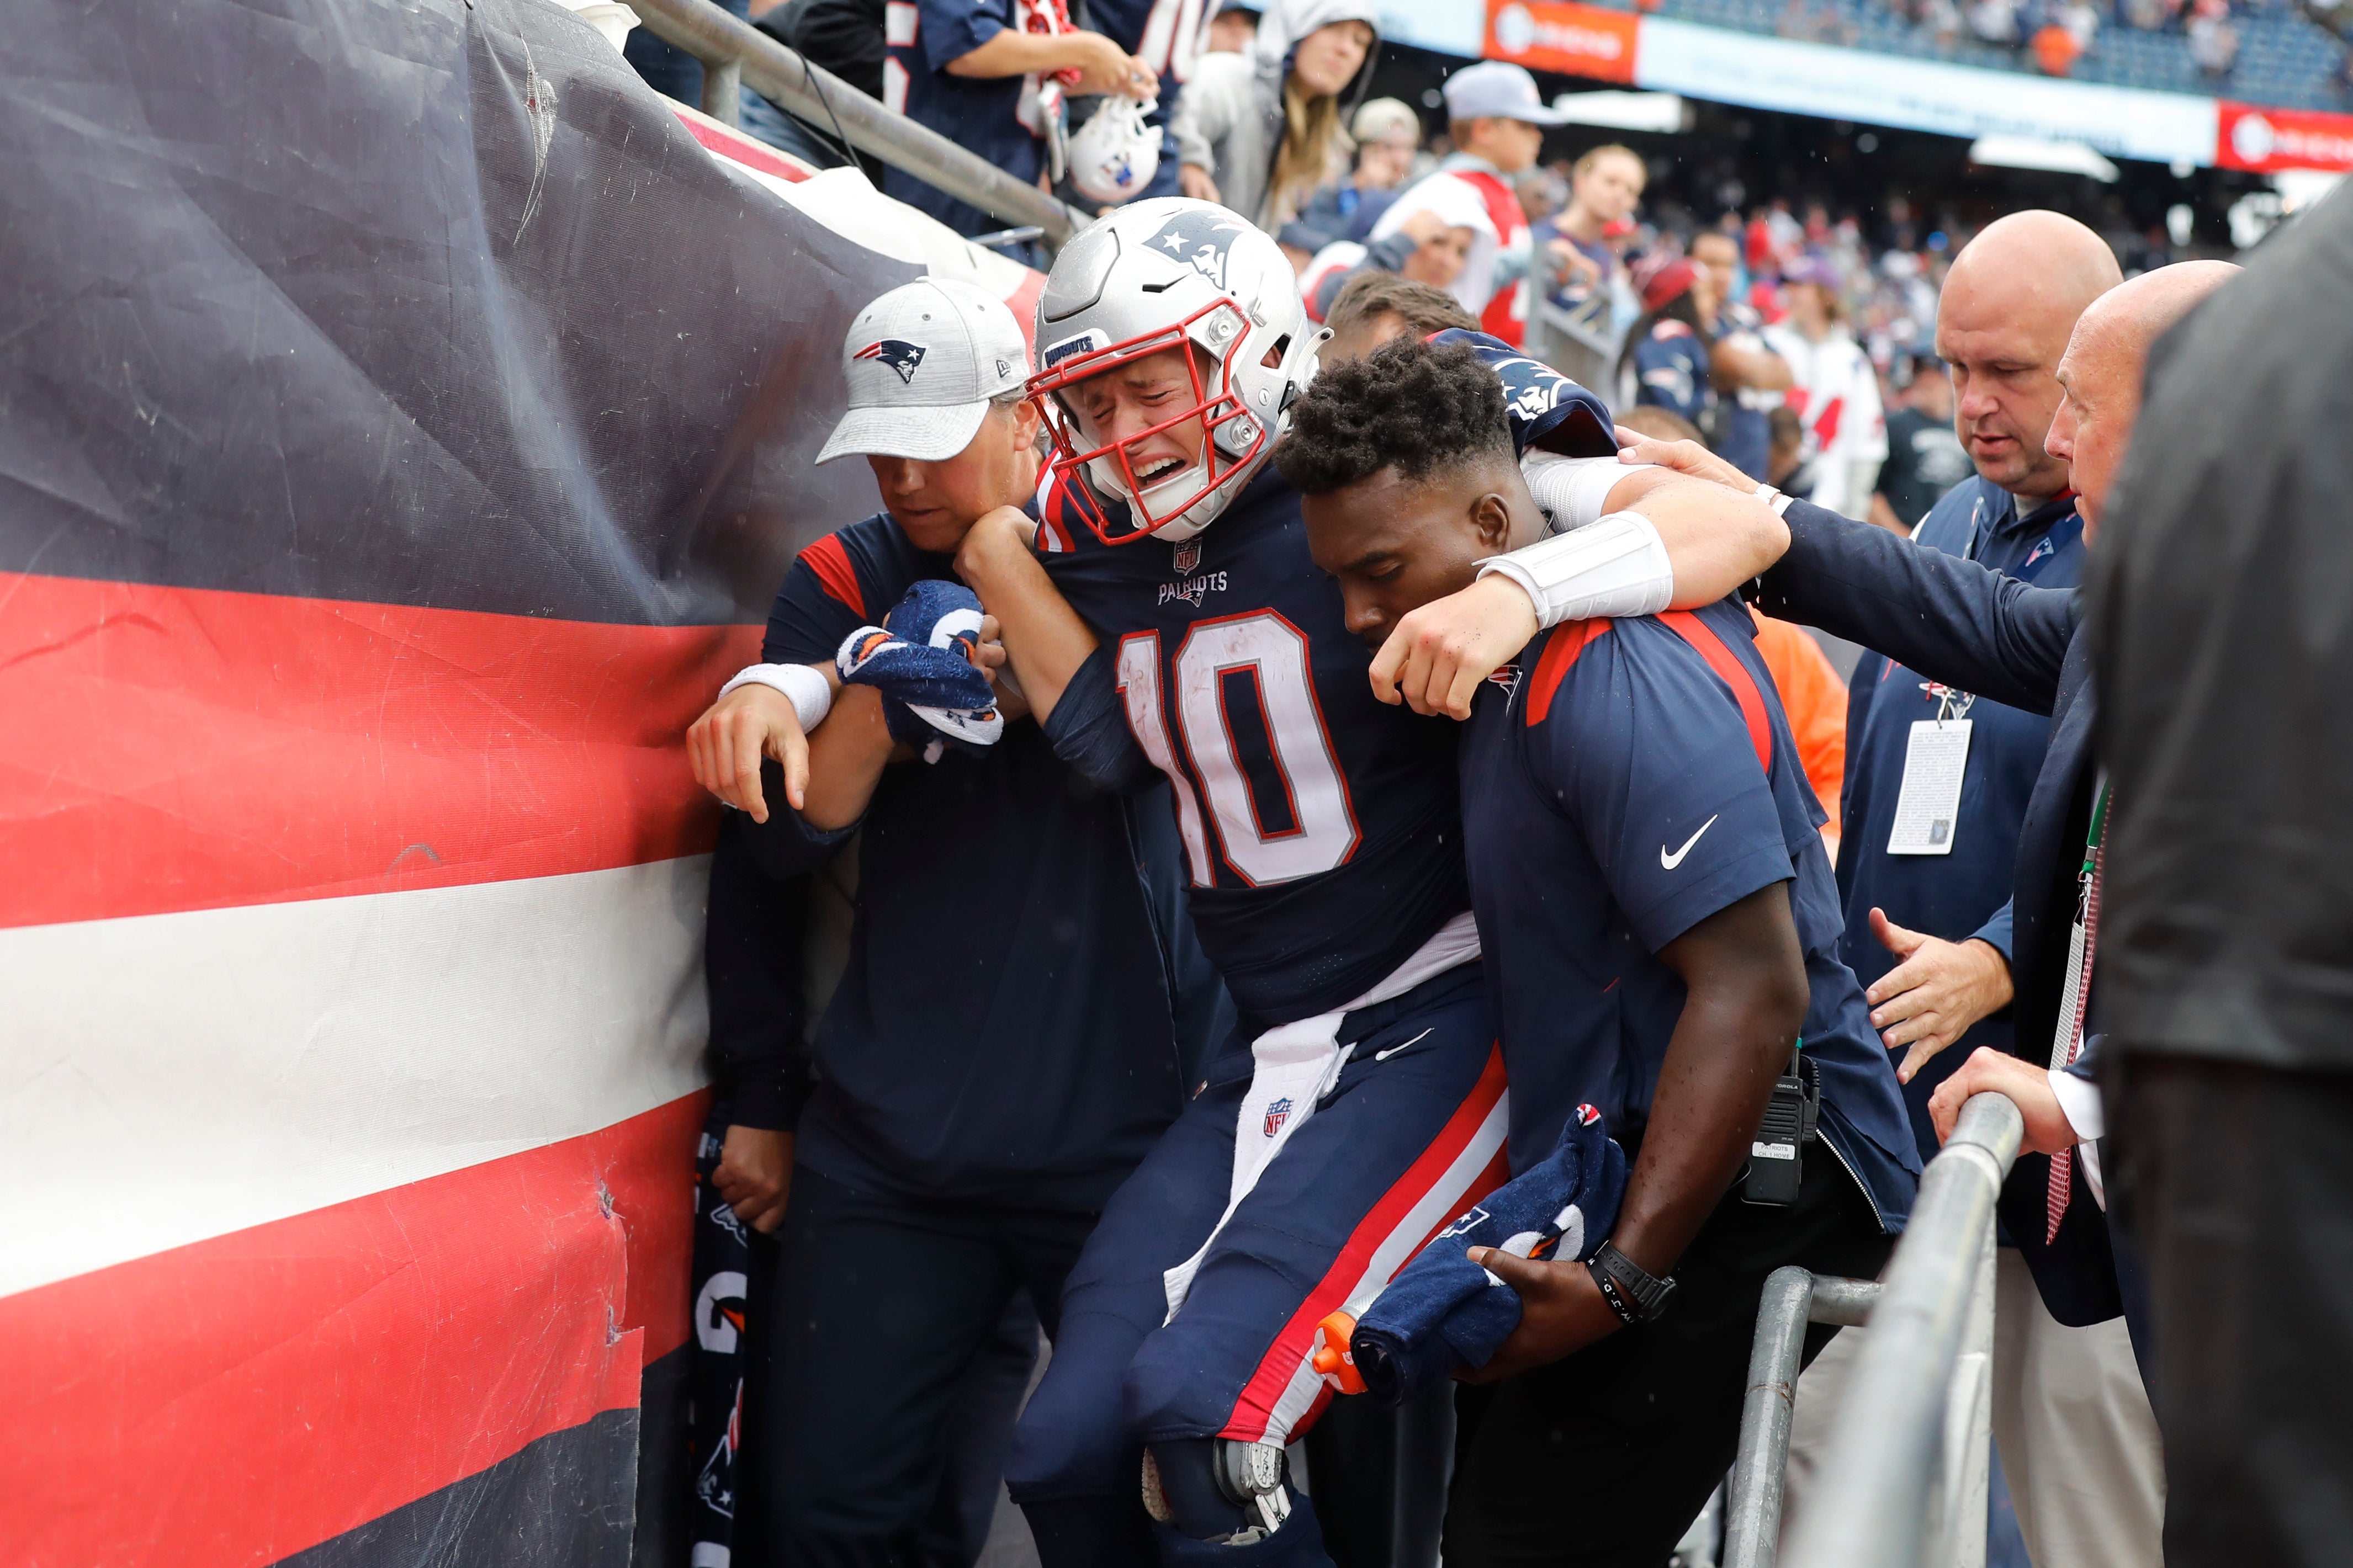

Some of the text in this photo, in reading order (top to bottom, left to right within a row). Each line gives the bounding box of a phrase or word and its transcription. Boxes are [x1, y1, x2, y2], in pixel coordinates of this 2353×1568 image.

[1045, 336, 1094, 369] PATRIOTS
[1177, 552, 1195, 568] NFL
[1158, 571, 1228, 606] PATRIOTS
[1115, 607, 1363, 888] 10
